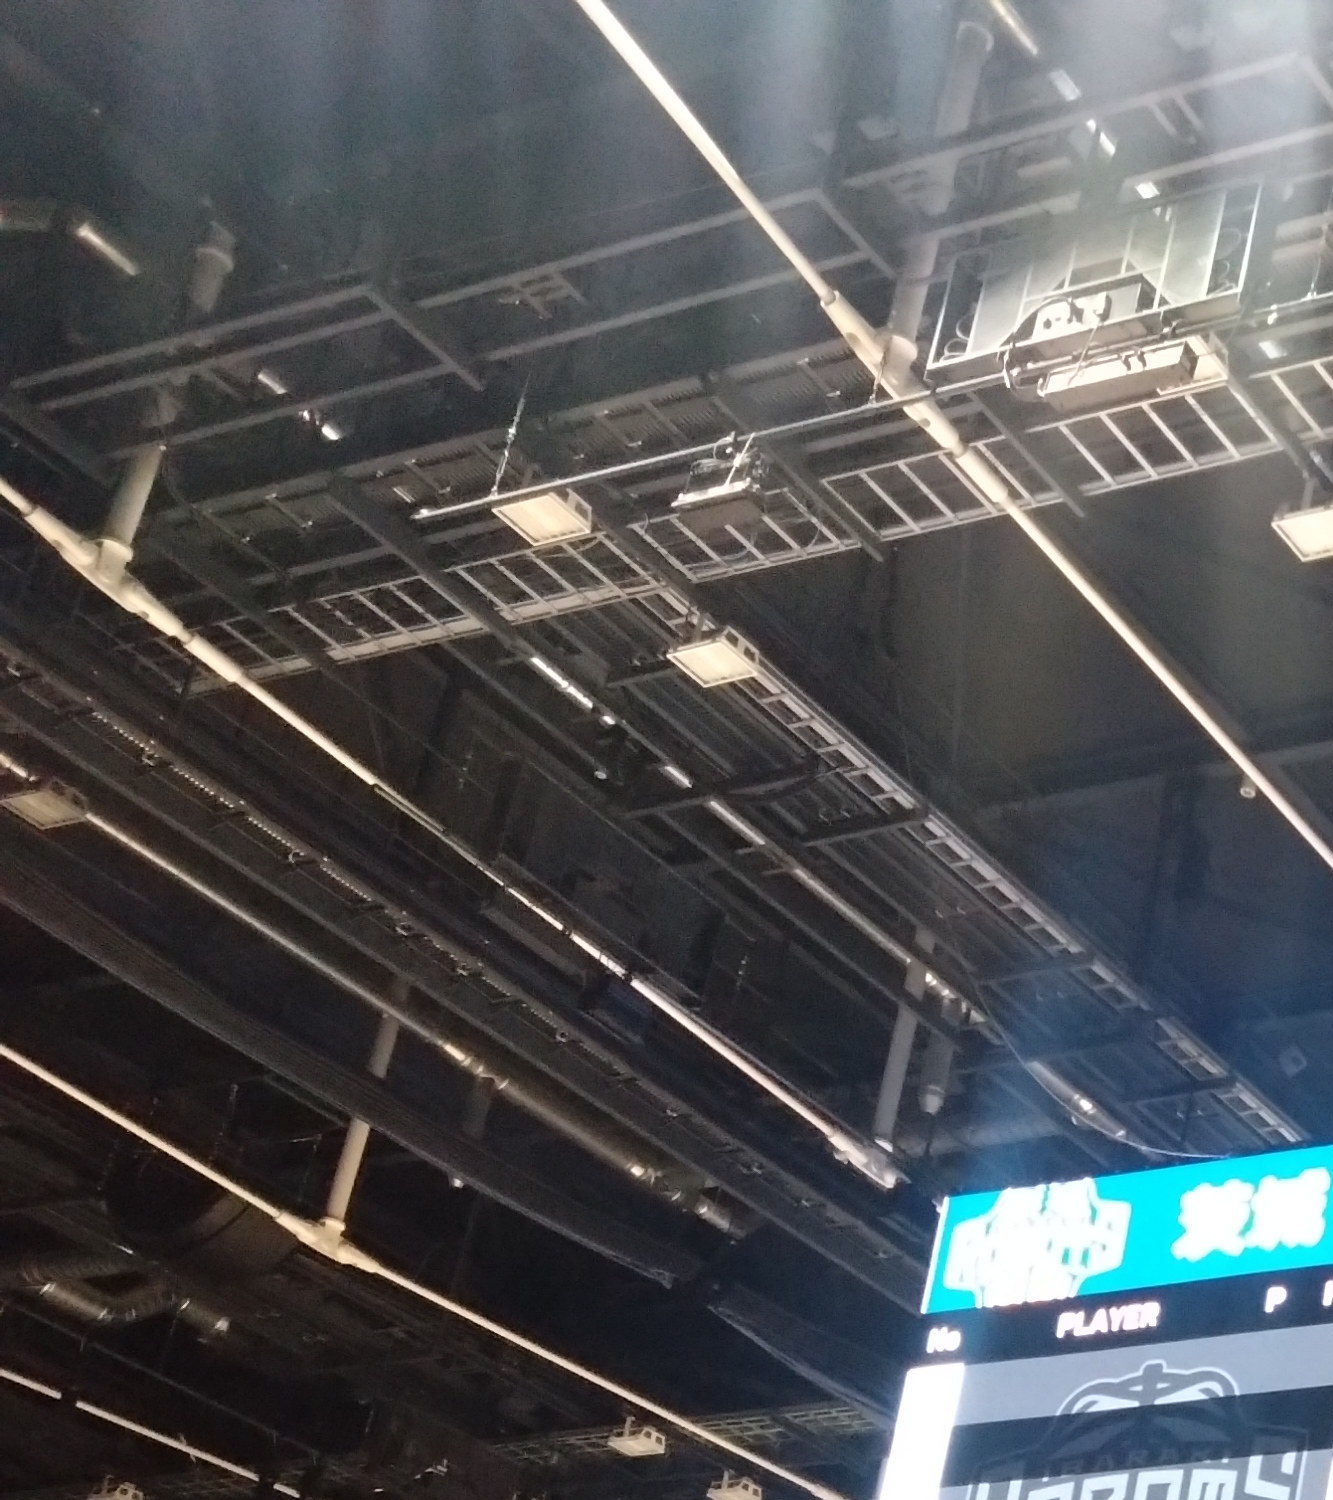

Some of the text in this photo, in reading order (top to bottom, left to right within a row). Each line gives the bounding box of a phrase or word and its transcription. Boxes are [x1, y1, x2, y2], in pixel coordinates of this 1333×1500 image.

[926, 1326, 962, 1354] No
[1056, 1301, 1161, 1339] PLAYER
[1264, 1286, 1288, 1313] P
